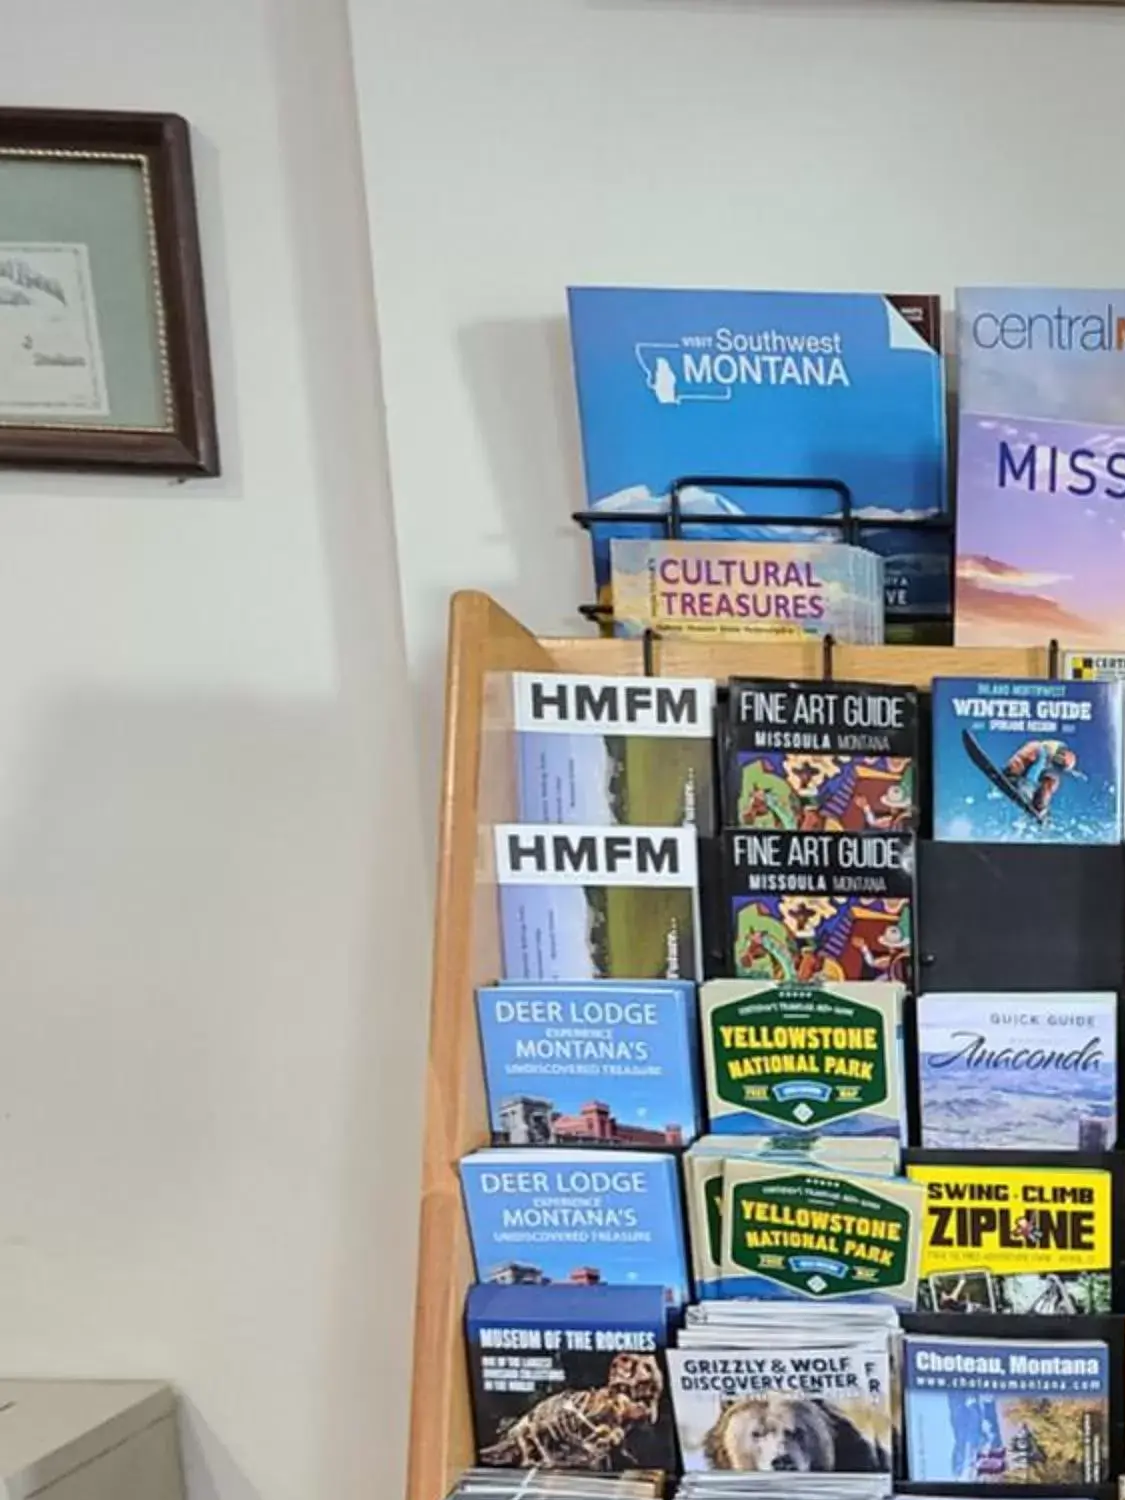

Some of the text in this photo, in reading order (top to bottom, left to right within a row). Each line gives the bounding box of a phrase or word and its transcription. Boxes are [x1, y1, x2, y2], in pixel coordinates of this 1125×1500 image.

[716, 328, 842, 354] Southwest
[682, 355, 850, 387] MONTANA
[659, 558, 822, 588] CULTURAL
[661, 591, 825, 619] TREASURES
[531, 682, 698, 724] HMFM
[741, 691, 905, 729] FINE ART GUIDE
[952, 698, 1092, 720] WINTER GUIDE
[755, 731, 890, 751] MISSOULA MONTANA
[508, 834, 681, 874] HMFM
[733, 836, 901, 870] FINE ART GUIDE
[749, 875, 888, 892] MISSOULA MONTANA
[495, 1001, 658, 1025] DEER LODGE
[990, 1014, 1096, 1028] QUICK GUIDE
[719, 1026, 878, 1049] YELLOWSTONE
[515, 1040, 648, 1060] MONTANA'S
[928, 1031, 1102, 1071] Anaconda
[727, 1054, 875, 1081] NATIONAL PARK
[481, 1171, 648, 1193] DEER LODGE
[928, 1182, 1094, 1204] SWING CLIMB
[502, 1209, 638, 1227] MONTANA'S
[741, 1200, 902, 1242] YELLOWSTONE
[928, 1207, 1095, 1250] ZIPLINE
[745, 1230, 895, 1266] NATIONAL PARK
[479, 1328, 657, 1351] MUSEUM OF THE ROCKIES
[684, 1357, 850, 1375] GRIZZLY & WOLF
[916, 1350, 1100, 1375] Choteau, Montana
[681, 1375, 786, 1393] DISCOVERY
[787, 1374, 858, 1392] CENTER
[916, 1377, 1101, 1391] www.choteaumontana.com
